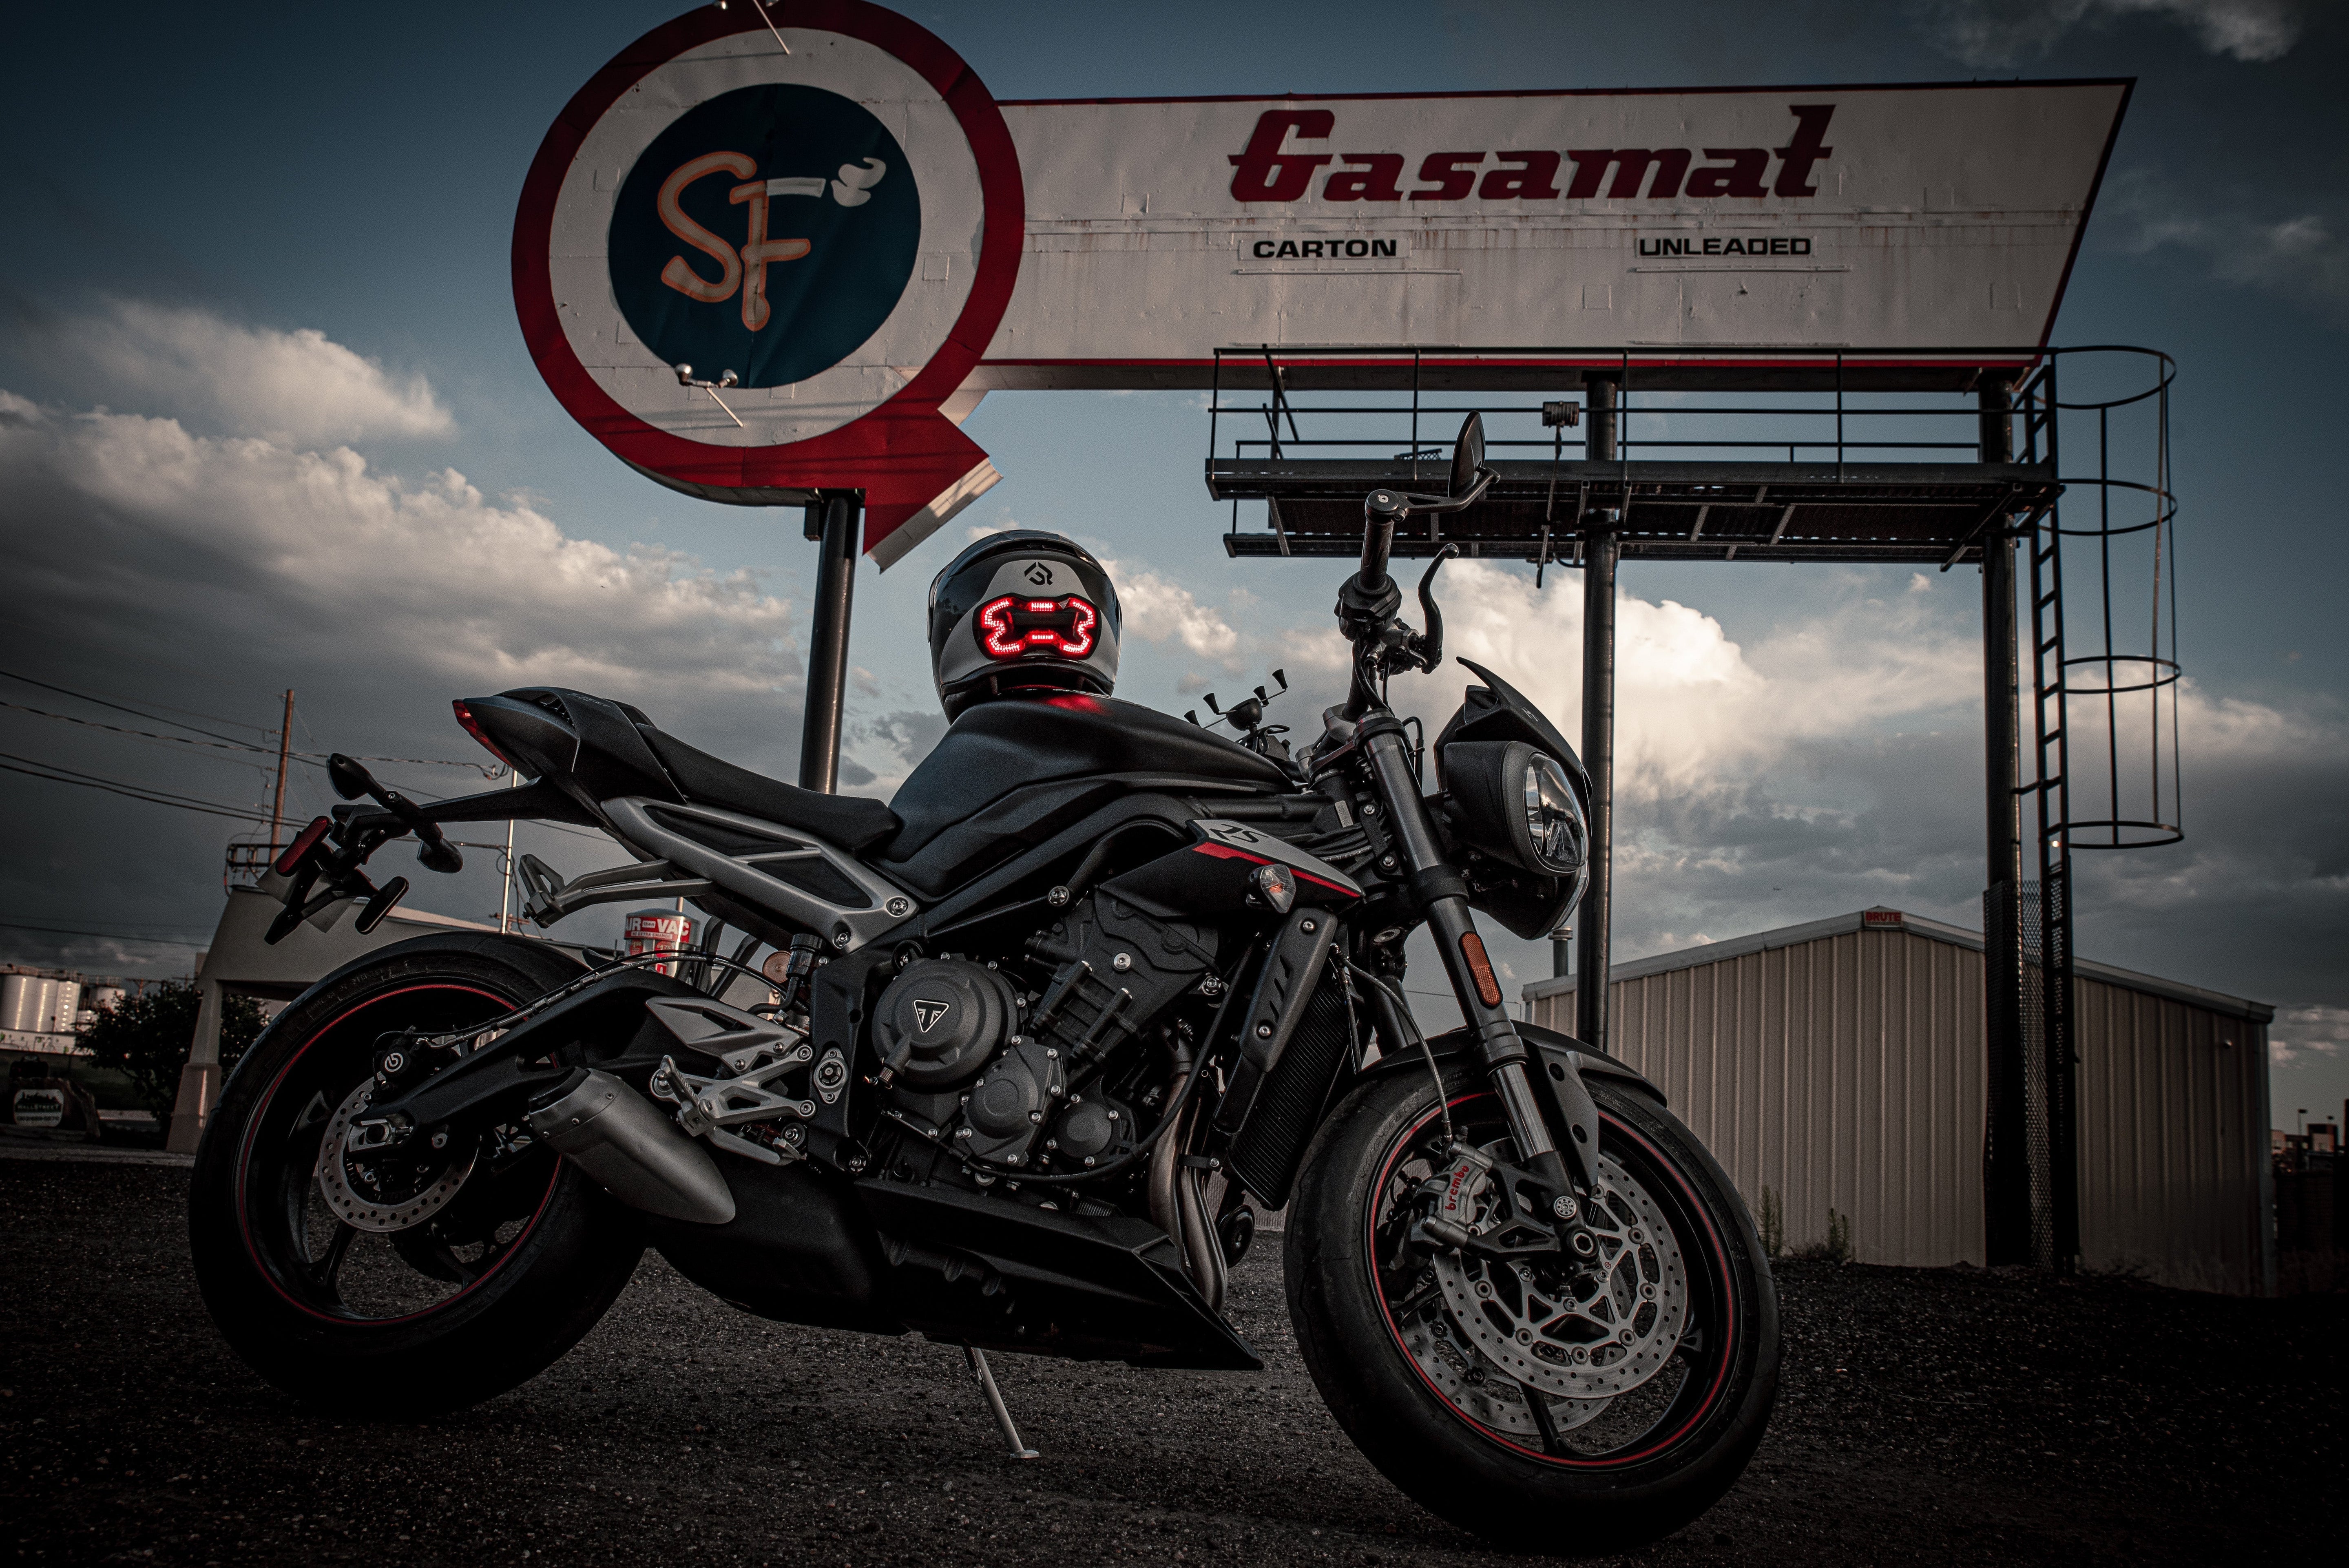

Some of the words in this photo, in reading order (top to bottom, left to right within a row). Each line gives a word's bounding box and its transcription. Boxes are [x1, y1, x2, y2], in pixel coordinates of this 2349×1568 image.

[1228, 104, 1836, 202] Gasamat
[1253, 239, 1397, 258] CARTON
[1639, 237, 1812, 256] UNLEADED
[1209, 823, 1270, 843] RS
[1865, 912, 1900, 921] BRUTE
[657, 919, 690, 936] VAC
[1445, 1165, 1469, 1210] brembo
